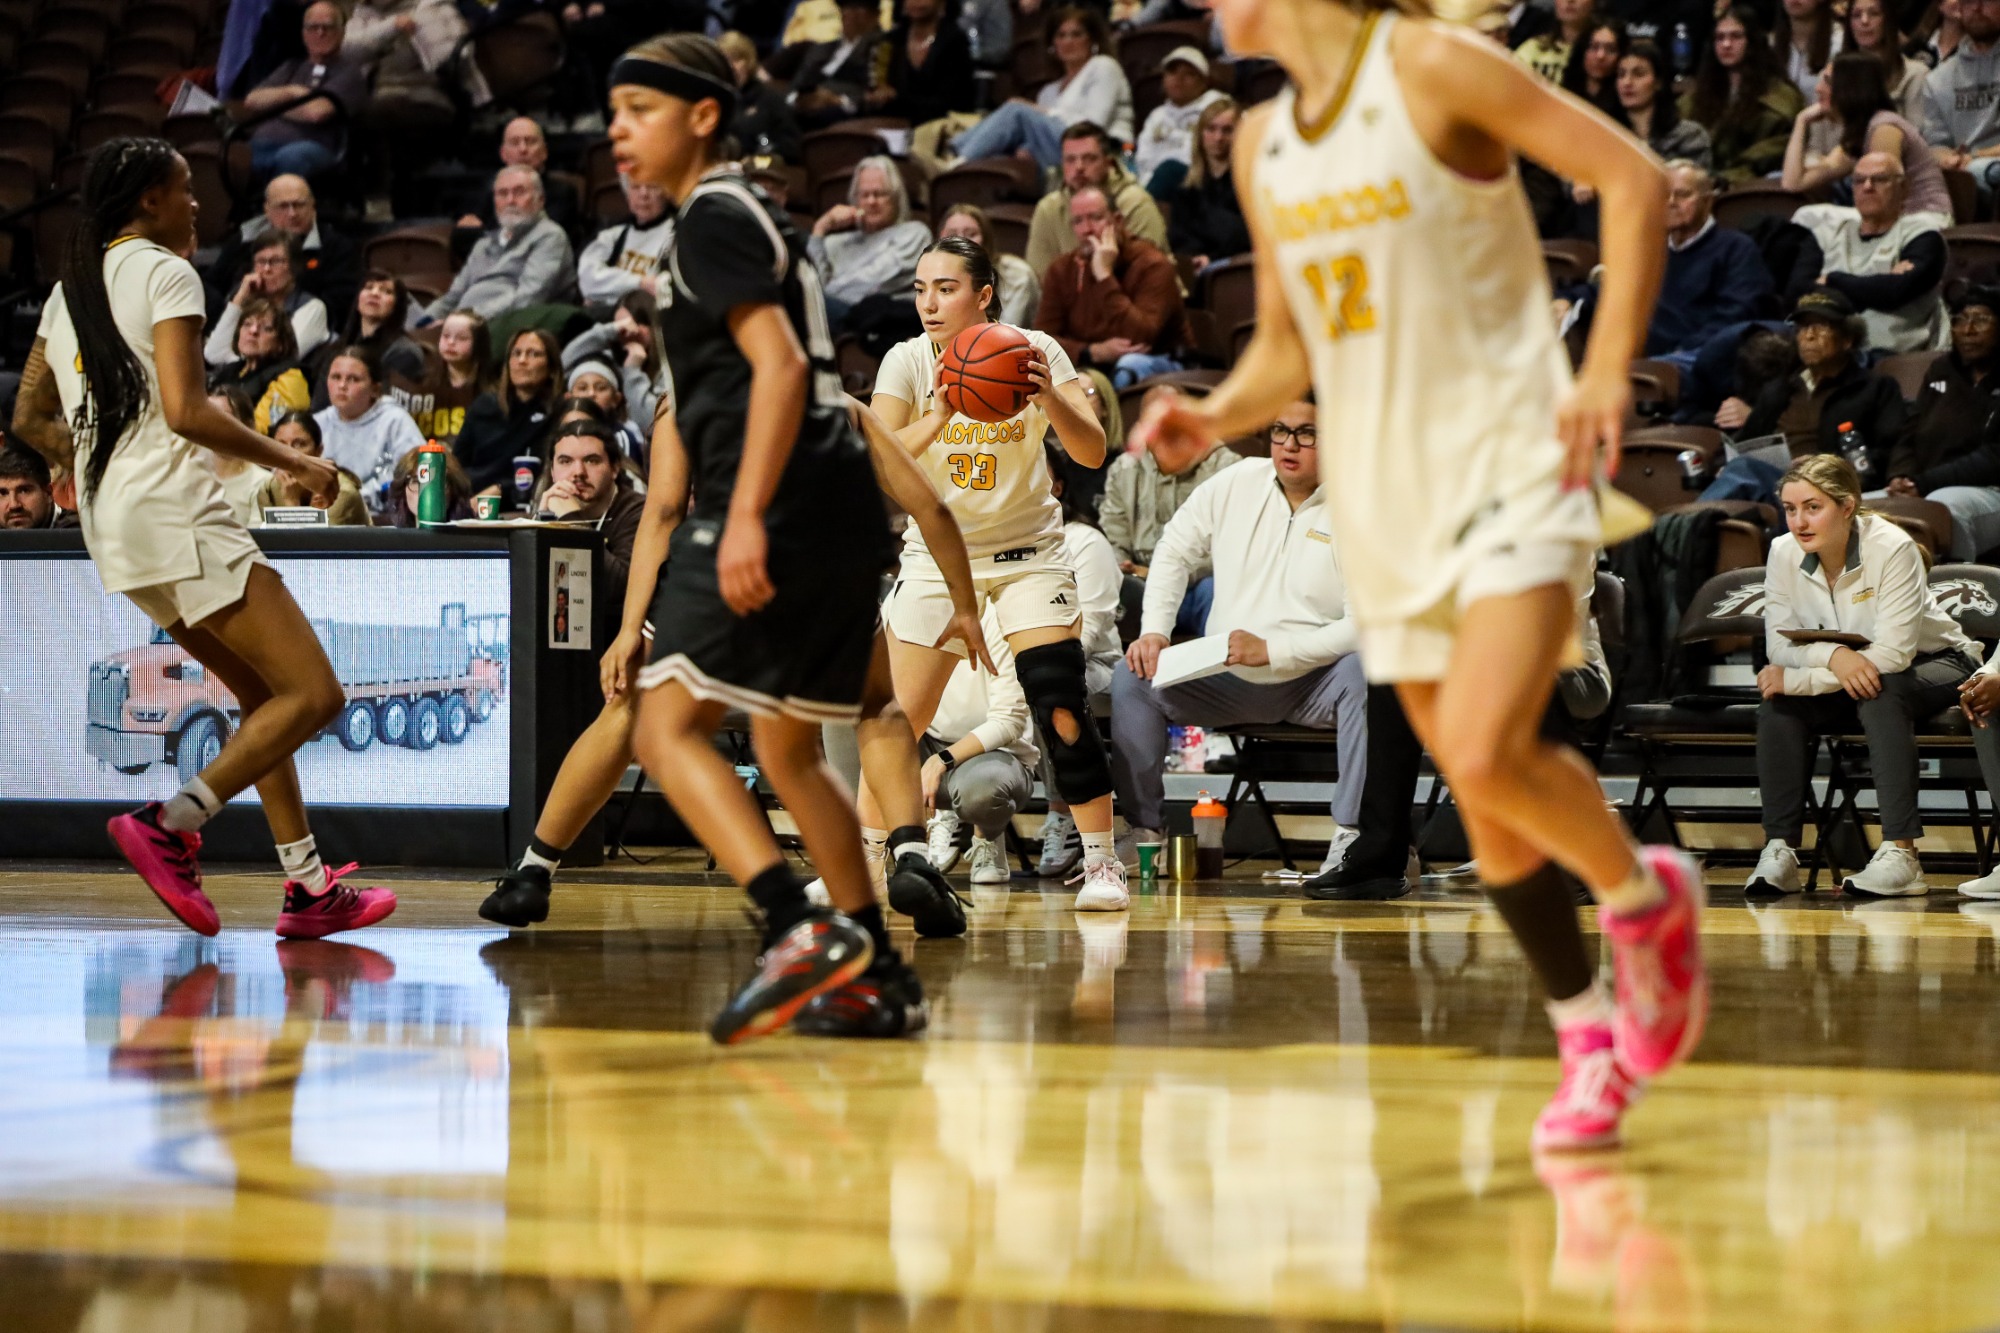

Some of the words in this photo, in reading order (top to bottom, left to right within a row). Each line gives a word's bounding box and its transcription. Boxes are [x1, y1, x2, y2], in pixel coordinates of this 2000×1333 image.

[1303, 254, 1376, 341] 12
[932, 416, 1026, 444] roncos
[948, 453, 997, 490] 33
